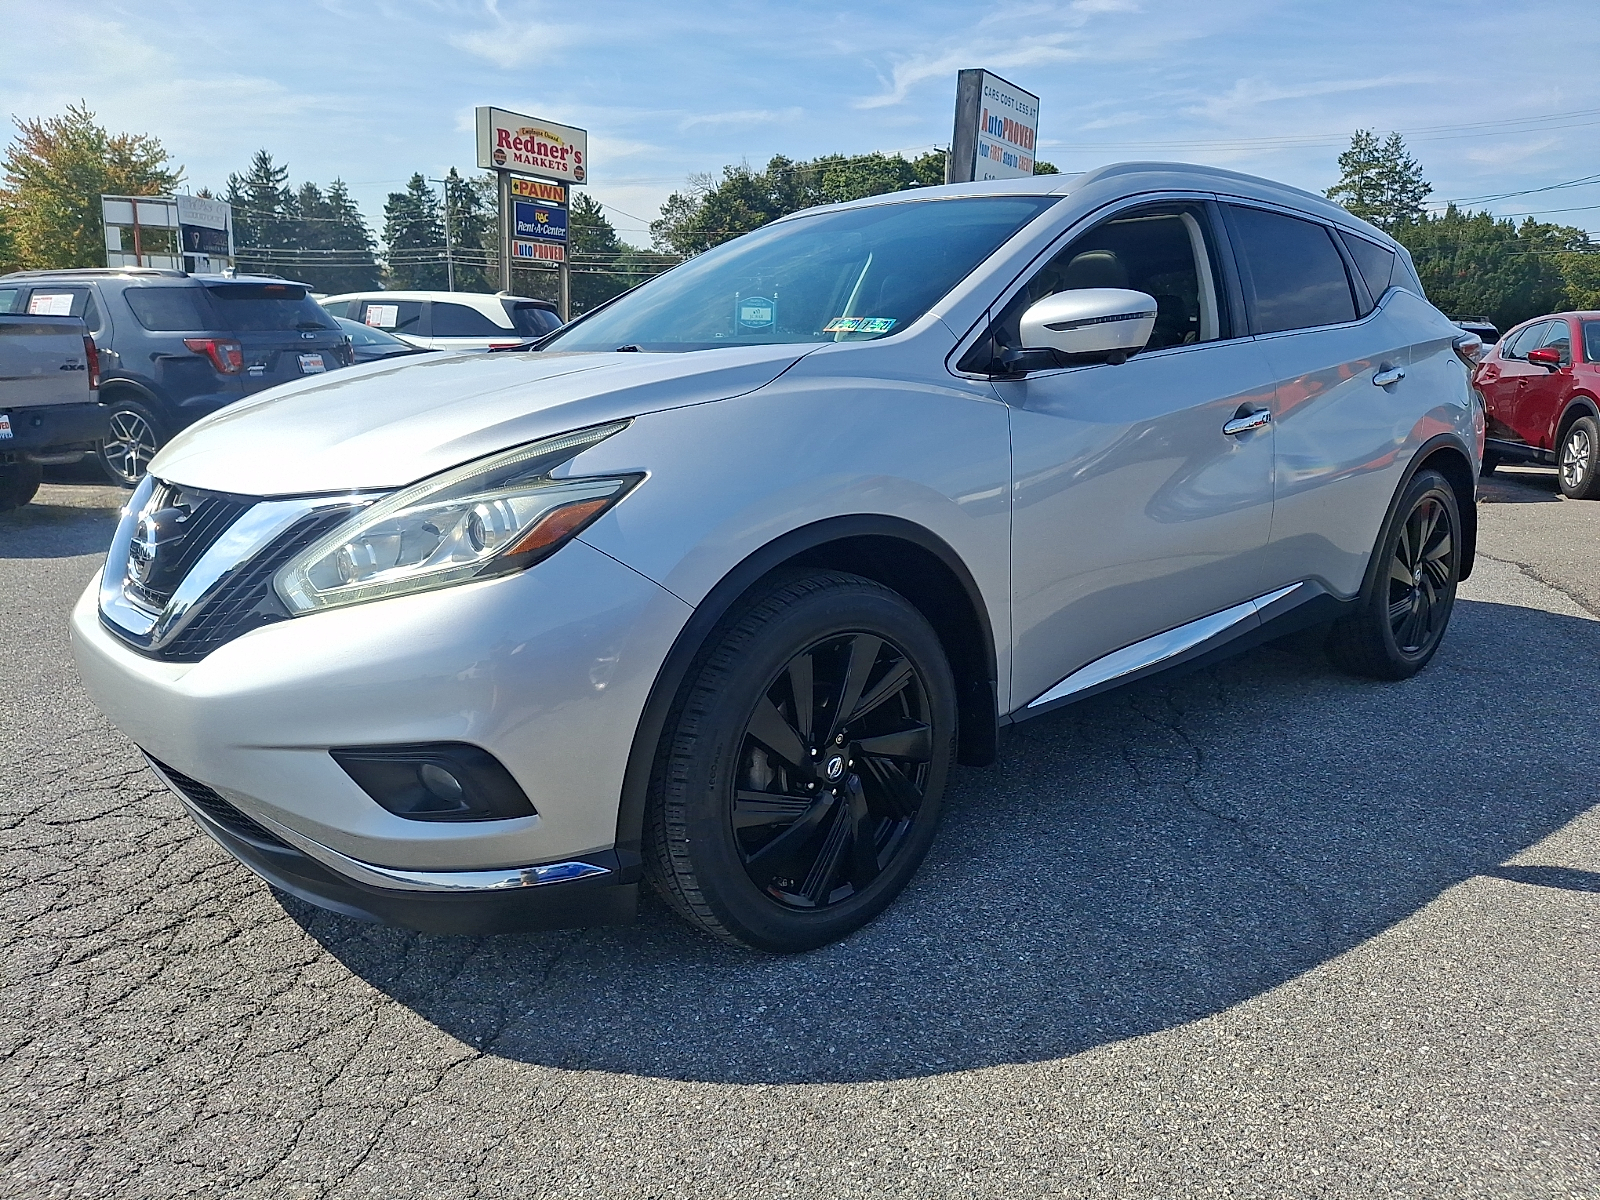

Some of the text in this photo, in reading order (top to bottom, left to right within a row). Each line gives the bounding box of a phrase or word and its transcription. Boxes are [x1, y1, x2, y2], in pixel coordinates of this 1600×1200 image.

[984, 85, 1036, 119] CARS COST LESS AT
[981, 107, 1034, 151] AutoPROVED
[496, 128, 583, 164] Redner's
[513, 152, 568, 172] MARKETS
[519, 181, 563, 201] PAWN
[513, 241, 564, 261] AutoPROVED
